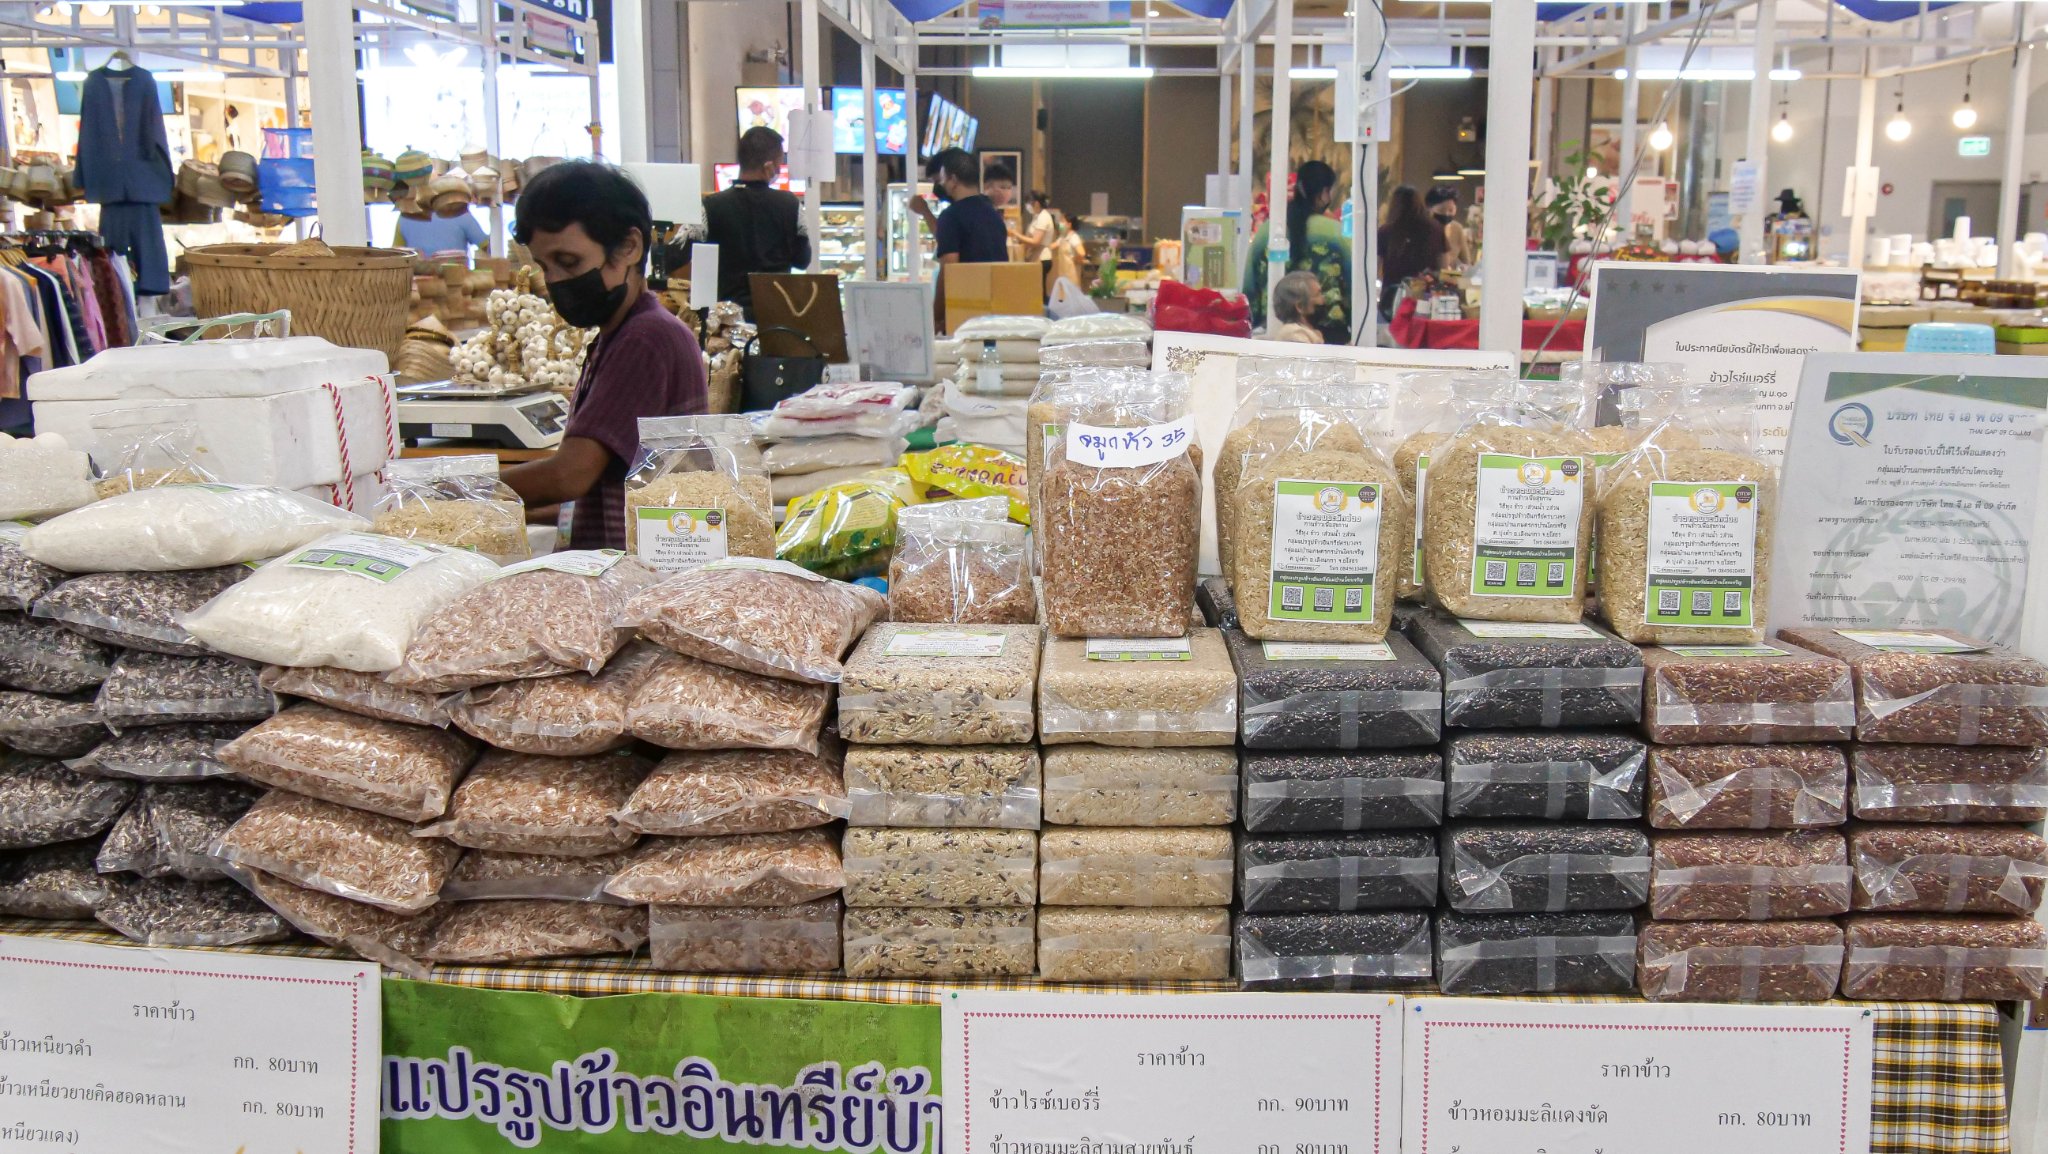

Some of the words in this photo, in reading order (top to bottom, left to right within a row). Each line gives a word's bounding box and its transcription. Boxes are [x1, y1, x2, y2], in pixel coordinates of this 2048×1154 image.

[1161, 428, 1186, 447] 35
[133, 1000, 196, 1022] ราคาข้าว
[0, 1030, 92, 1057] ข้าวเหนียวดำ
[233, 1055, 259, 1071] กก.
[269, 1057, 319, 1074] 80บาท
[1137, 1045, 1206, 1067] ราคาข้าว
[1600, 1057, 1671, 1078] ราคาข้าว
[380, 1048, 943, 1154] แปรรูปข้าวอินทรีย์บ้า
[989, 1087, 1101, 1111] ข้าวไรซ์เบอร์รี่
[1257, 1098, 1285, 1112] กก.
[1295, 1097, 1349, 1112] 90บาท
[242, 1101, 267, 1116] กก.
[276, 1102, 324, 1119] 80บาท
[1448, 1099, 1608, 1124] ข้าวหอมมะลิแดงขัด
[1718, 1112, 1746, 1127] กก.
[1756, 1112, 1812, 1127] 80บาท
[2, 1122, 79, 1145] หนียวแดง)
[989, 1134, 1196, 1154] ข้าวหอมมะลิสามสายพันธ์
[1257, 1142, 1279, 1154] กก
